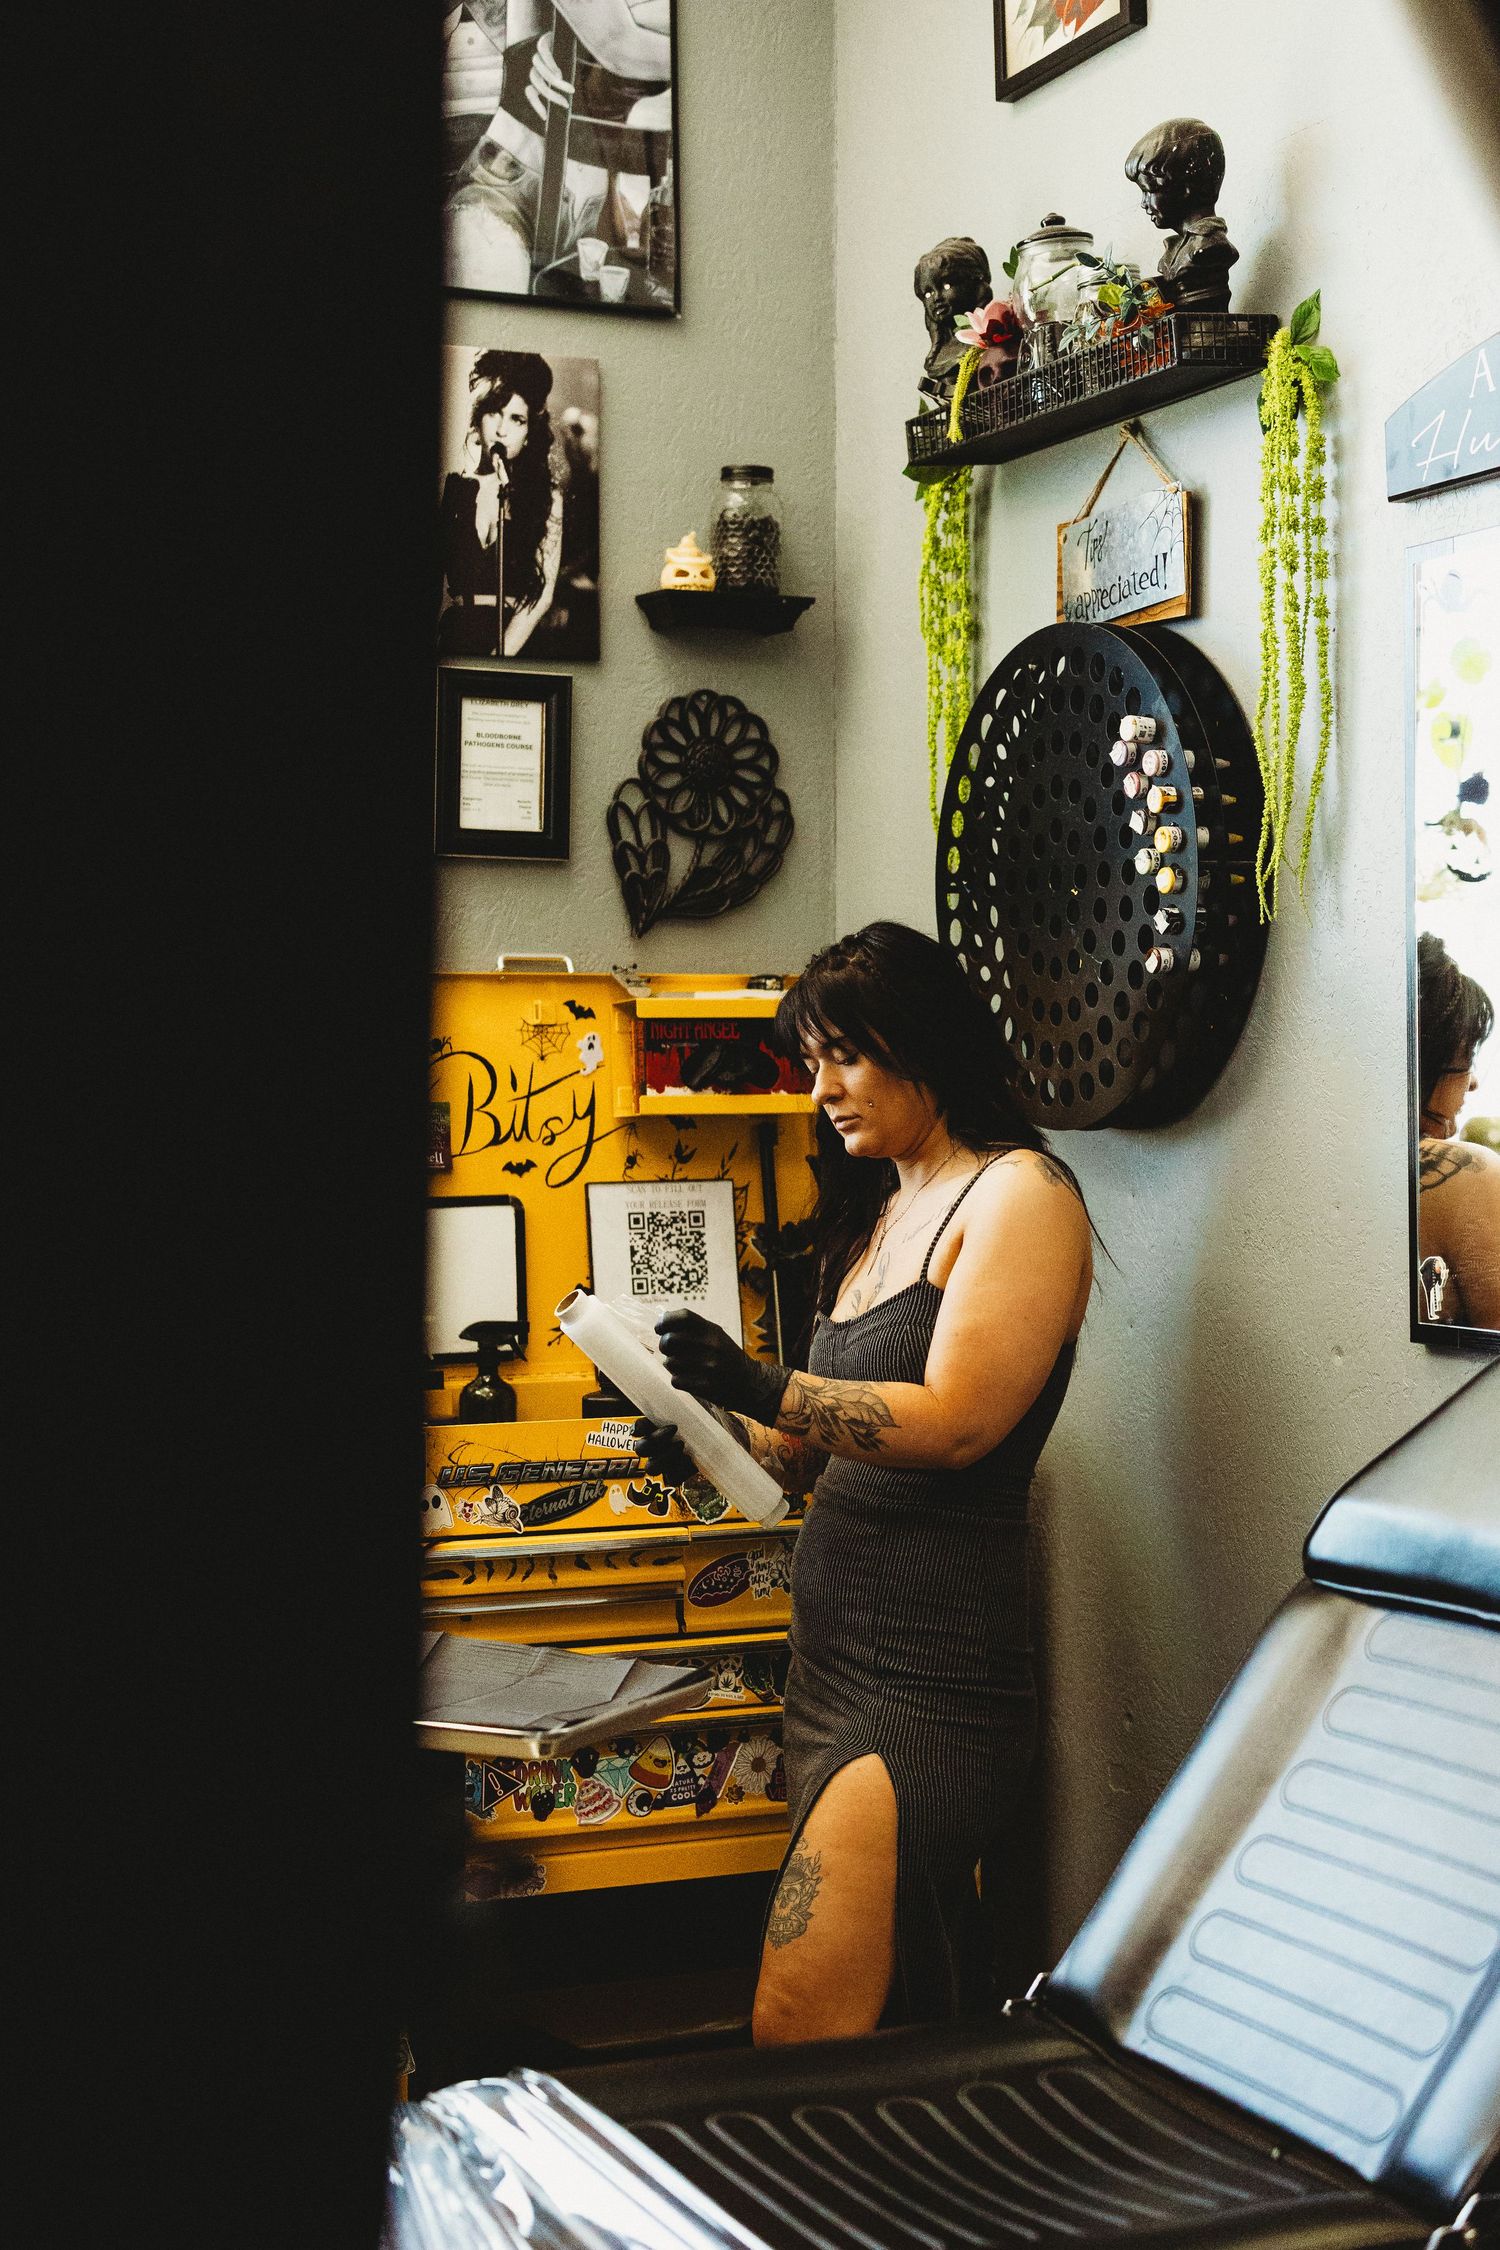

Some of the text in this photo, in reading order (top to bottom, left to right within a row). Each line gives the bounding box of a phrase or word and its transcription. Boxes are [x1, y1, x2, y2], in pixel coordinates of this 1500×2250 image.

[1076, 518, 1108, 571] Tips
[1074, 551, 1168, 621] appreciated!
[464, 740, 505, 749] PATHOGENS
[476, 732, 521, 740] BLOODBORNE
[650, 1022, 741, 1041] NIGHT ANGEL
[430, 1050, 637, 1189] Bitsy
[626, 1183, 703, 1194] SCAN TO FILL OUT
[625, 1199, 707, 1210] YOUR RELEASE FORM
[577, 1480, 609, 1505] Ink
[514, 1759, 575, 1785] DRINK
[512, 1783, 578, 1812] WER
[671, 1790, 697, 1801] COOL
